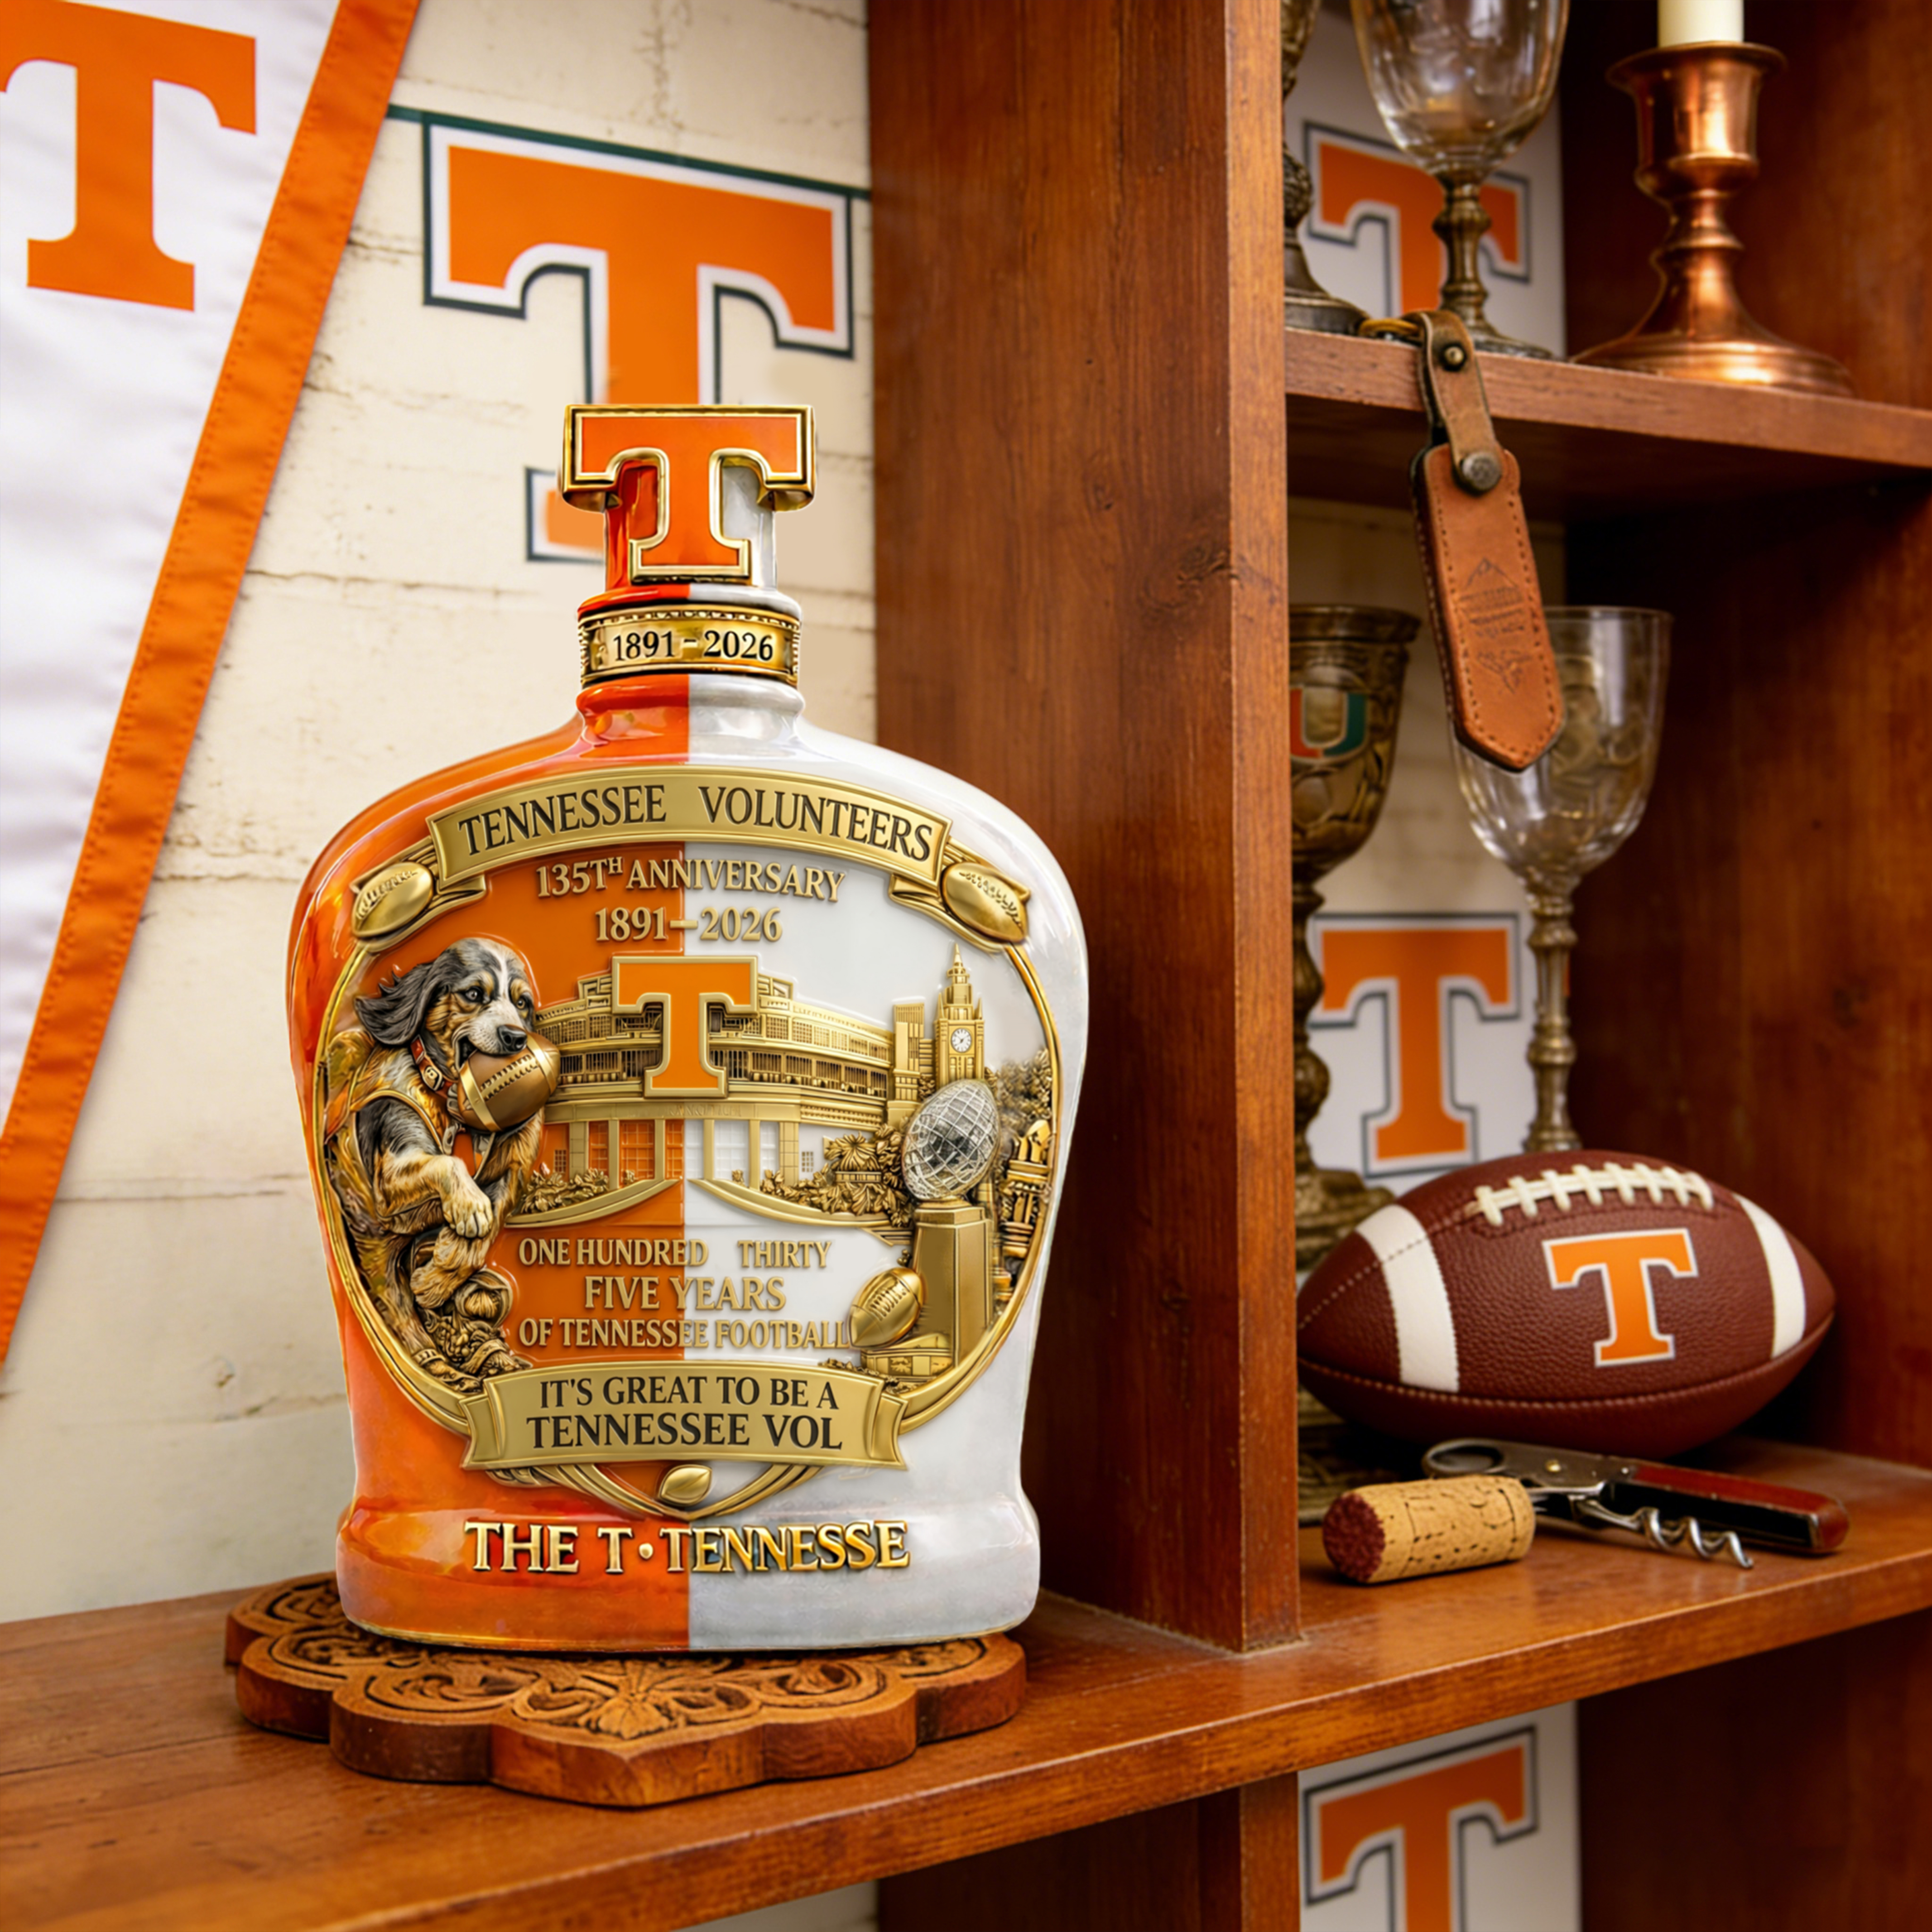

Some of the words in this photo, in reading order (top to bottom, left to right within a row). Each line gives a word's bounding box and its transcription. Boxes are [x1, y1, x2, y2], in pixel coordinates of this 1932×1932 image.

[0, 0, 256, 312] T
[423, 111, 854, 563] T
[562, 404, 815, 584] T
[458, 784, 667, 856] TENNESSEE
[698, 785, 933, 862] VOLUNTEERS
[536, 856, 623, 898] 135TH
[626, 858, 845, 902] ANNIVERSARY
[612, 956, 758, 1098] T
[1310, 912, 1522, 1180] T
[519, 1238, 571, 1266] ONE
[577, 1239, 709, 1267] HUNDRED
[737, 1240, 832, 1268] THIRTY
[585, 1276, 660, 1309] FIVE
[669, 1276, 787, 1311] YEARS
[1542, 1227, 1699, 1368] T
[519, 1318, 553, 1347] OF
[559, 1319, 710, 1348] TENNESSEE
[716, 1319, 850, 1349] FOOTBALL
[526, 1412, 750, 1450] TENNESSEE
[763, 1413, 843, 1451] VOL
[539, 1377, 593, 1410] IT'S
[602, 1376, 707, 1405] GREAT
[716, 1376, 759, 1406] TO
[770, 1379, 809, 1408] BE
[816, 1380, 839, 1410] A
[464, 1521, 580, 1573] THE
[1303, 1725, 1538, 1932] T
